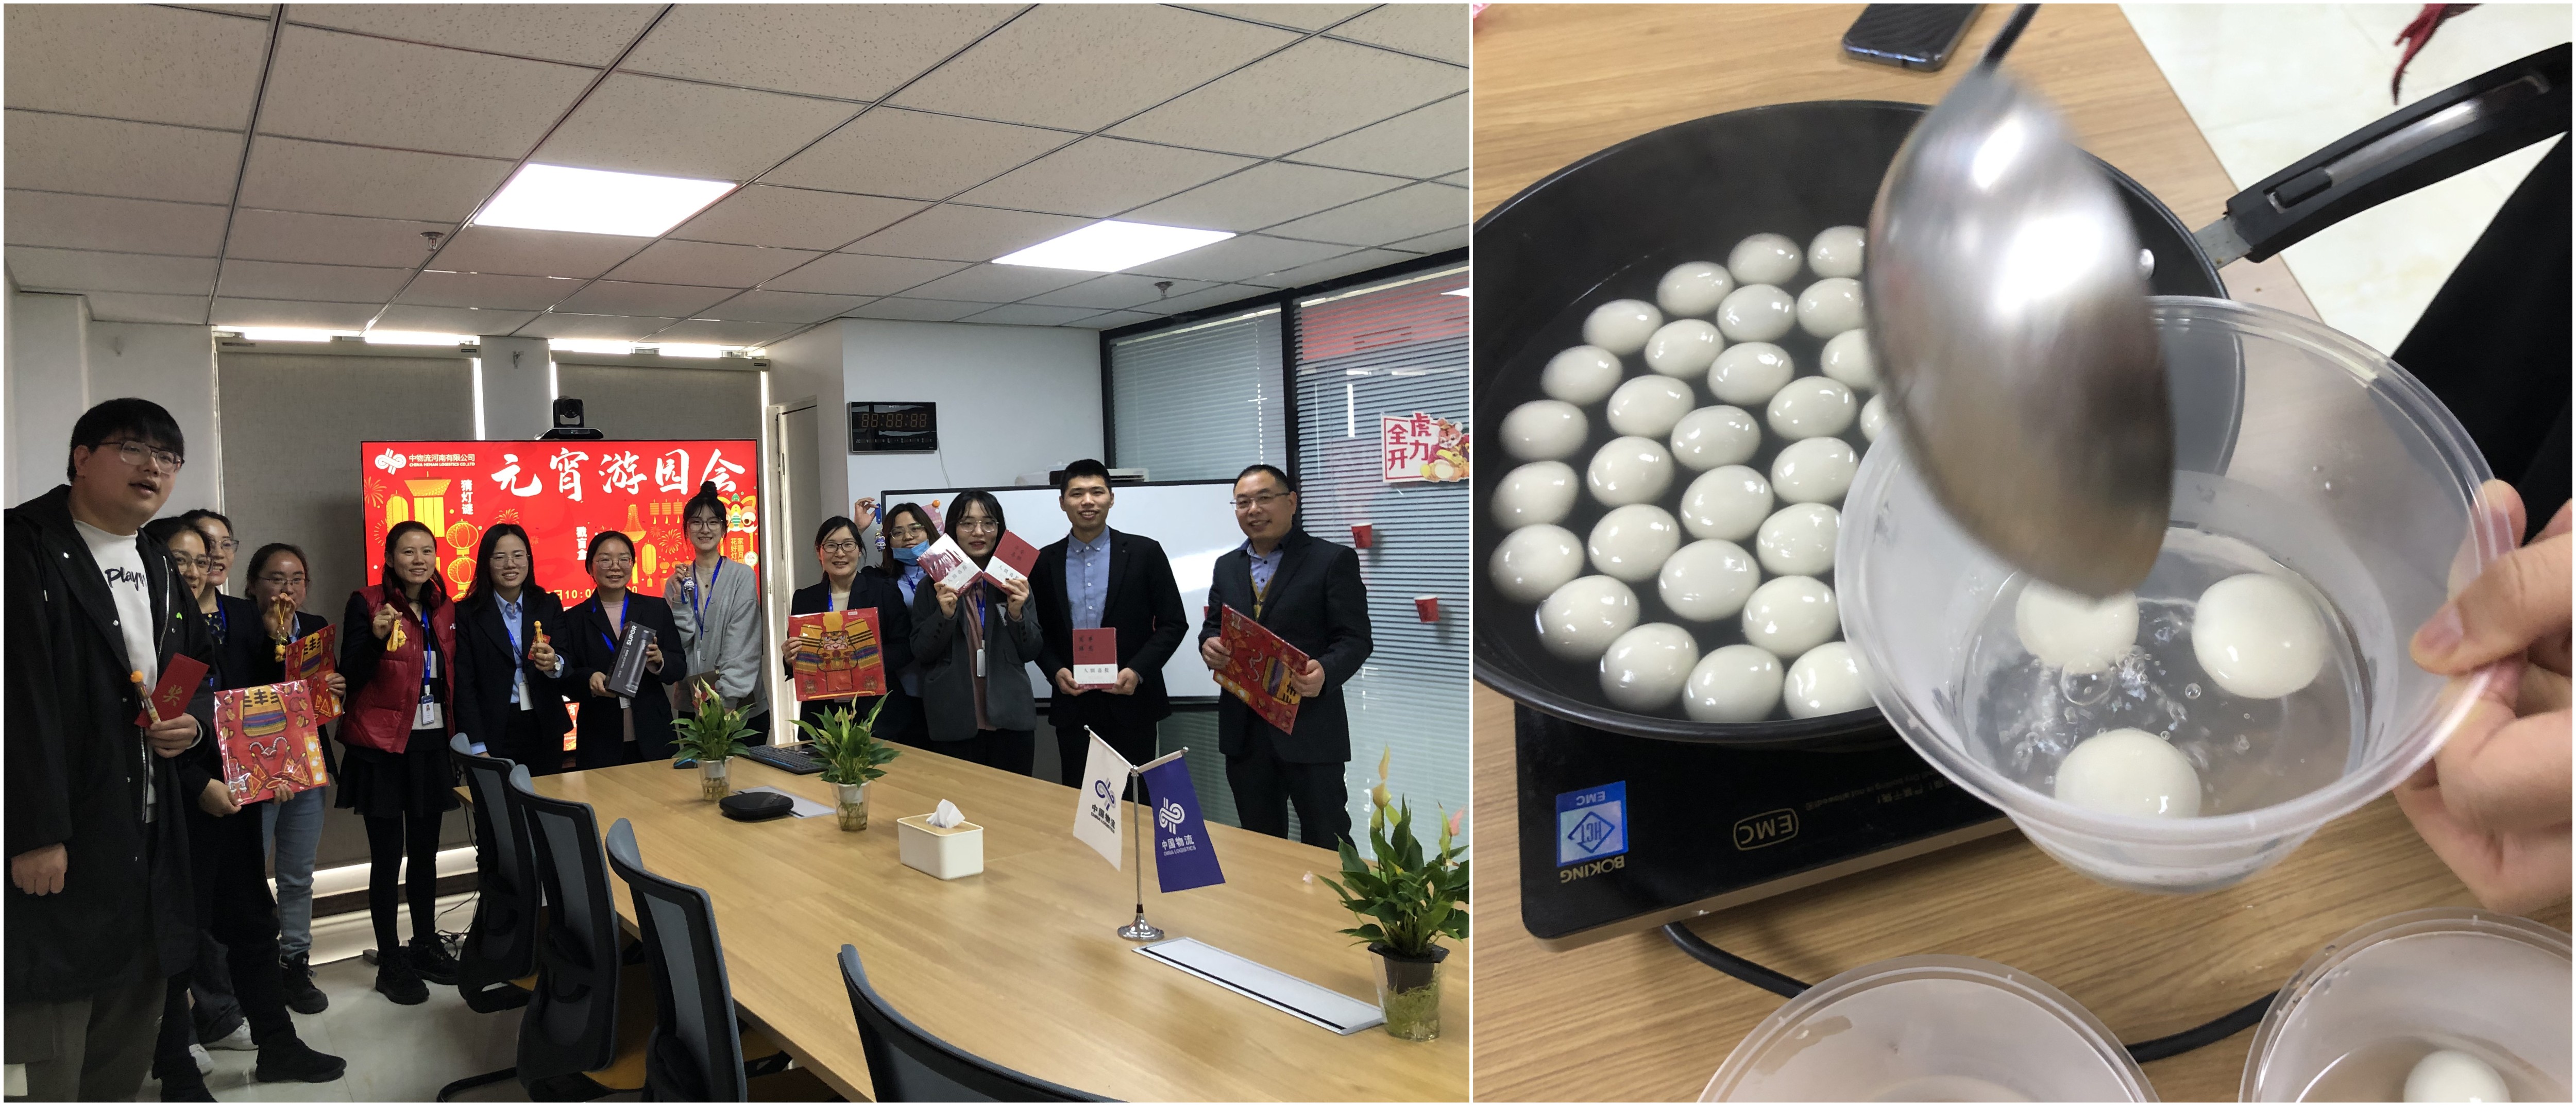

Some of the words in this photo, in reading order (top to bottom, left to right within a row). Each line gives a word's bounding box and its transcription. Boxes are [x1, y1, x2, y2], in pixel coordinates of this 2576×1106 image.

[1387, 424, 1408, 470] 全开
[1410, 413, 1431, 460] 虎力
[409, 454, 475, 462] 中物流河南有限公司
[491, 447, 745, 502] 元宵游园会
[461, 479, 474, 515] 猜灯谜
[626, 625, 637, 646] SUPOR
[1576, 791, 1606, 806] EMC
[1092, 804, 1115, 829] 中国物流
[1739, 814, 1793, 844] EMC
[1162, 835, 1194, 850] 中国物流
[1174, 845, 1196, 854] LOGISTICS
[1560, 855, 1625, 883] BOKING
